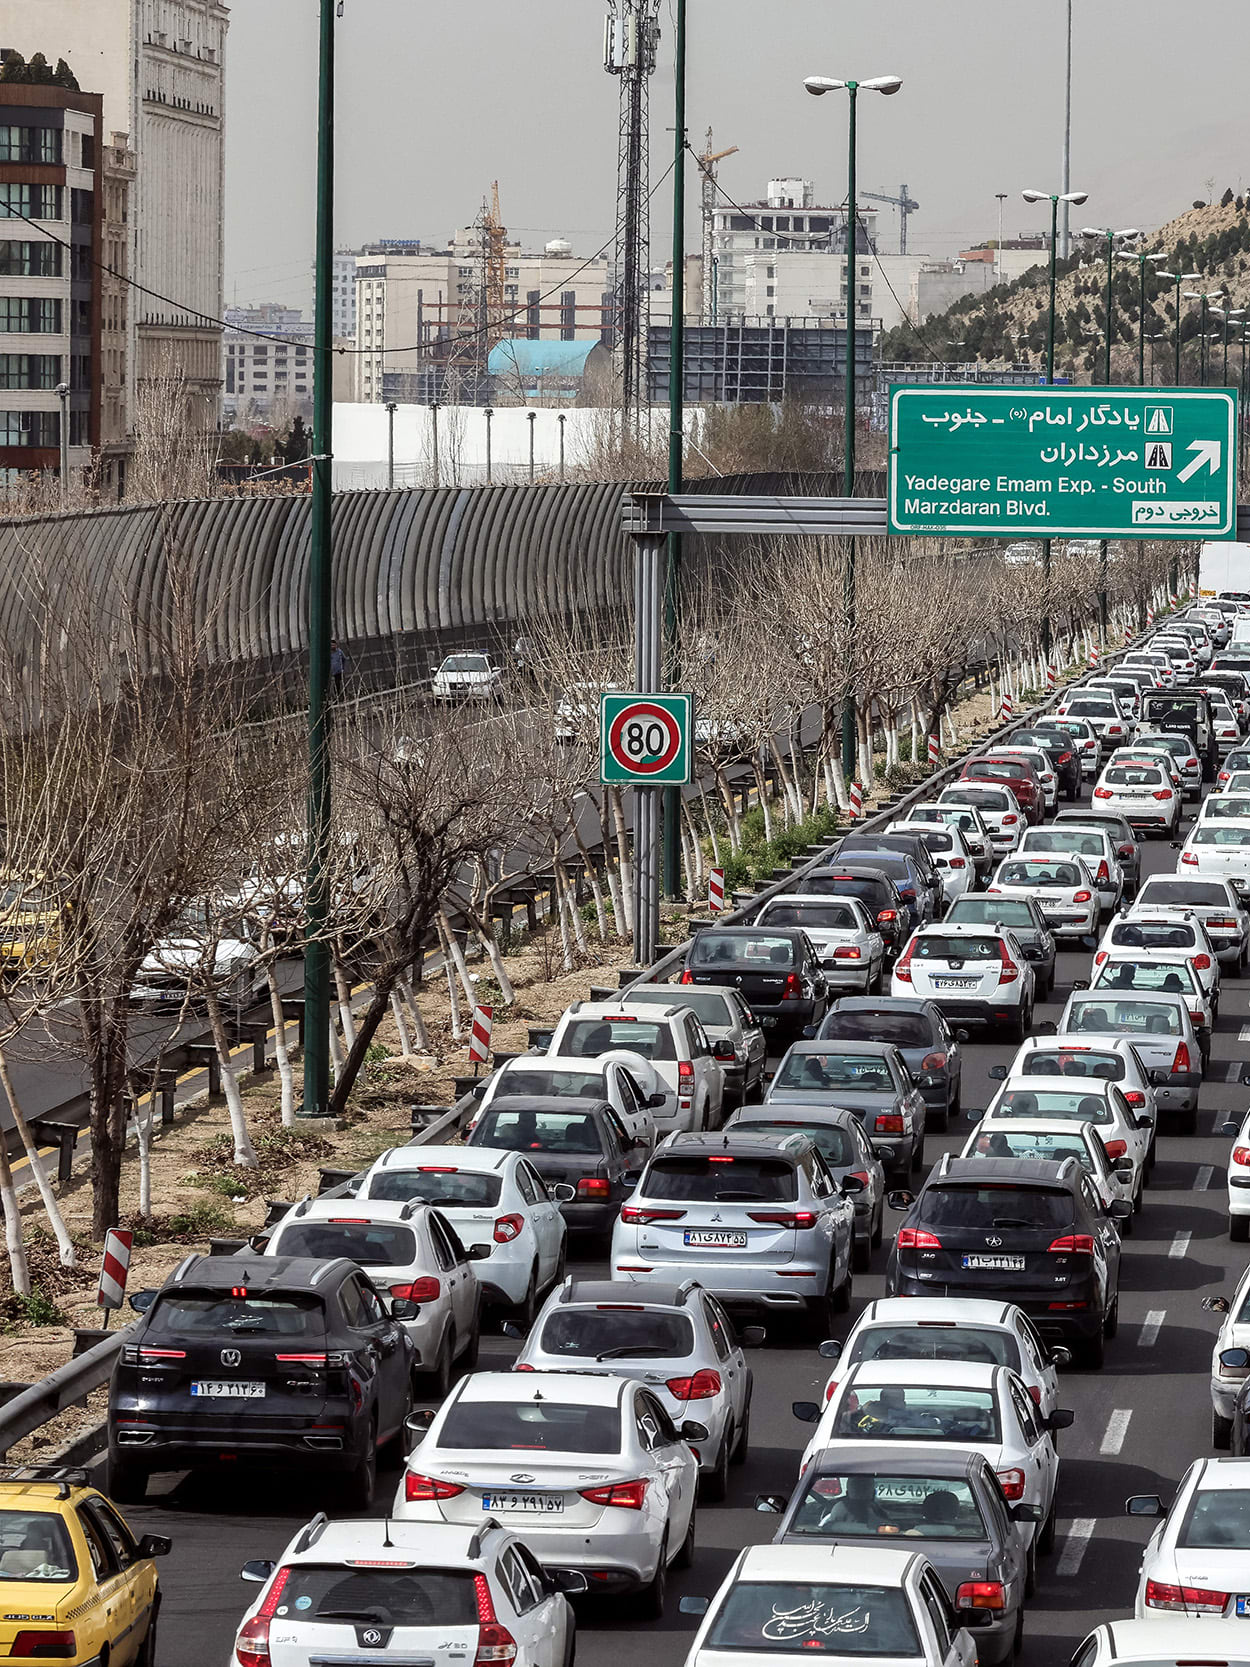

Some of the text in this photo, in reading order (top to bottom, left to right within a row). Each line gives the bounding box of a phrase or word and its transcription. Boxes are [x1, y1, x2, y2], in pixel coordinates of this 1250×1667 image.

[921, 408, 988, 432] جنوب
[1075, 404, 1140, 433] یادگار
[1040, 442, 1139, 468] مرزداران
[904, 474, 991, 494] Yadegare
[996, 476, 1052, 493] Emam
[1058, 476, 1096, 495] Exp.
[1112, 477, 1167, 494] South
[904, 498, 1051, 516] Marzdaran Blvd.
[1135, 505, 1219, 522] خروجی دوم
[627, 722, 665, 756] 80
[491, 1496, 507, 1508] ۸۳
[547, 1500, 562, 1511] ۵۷
